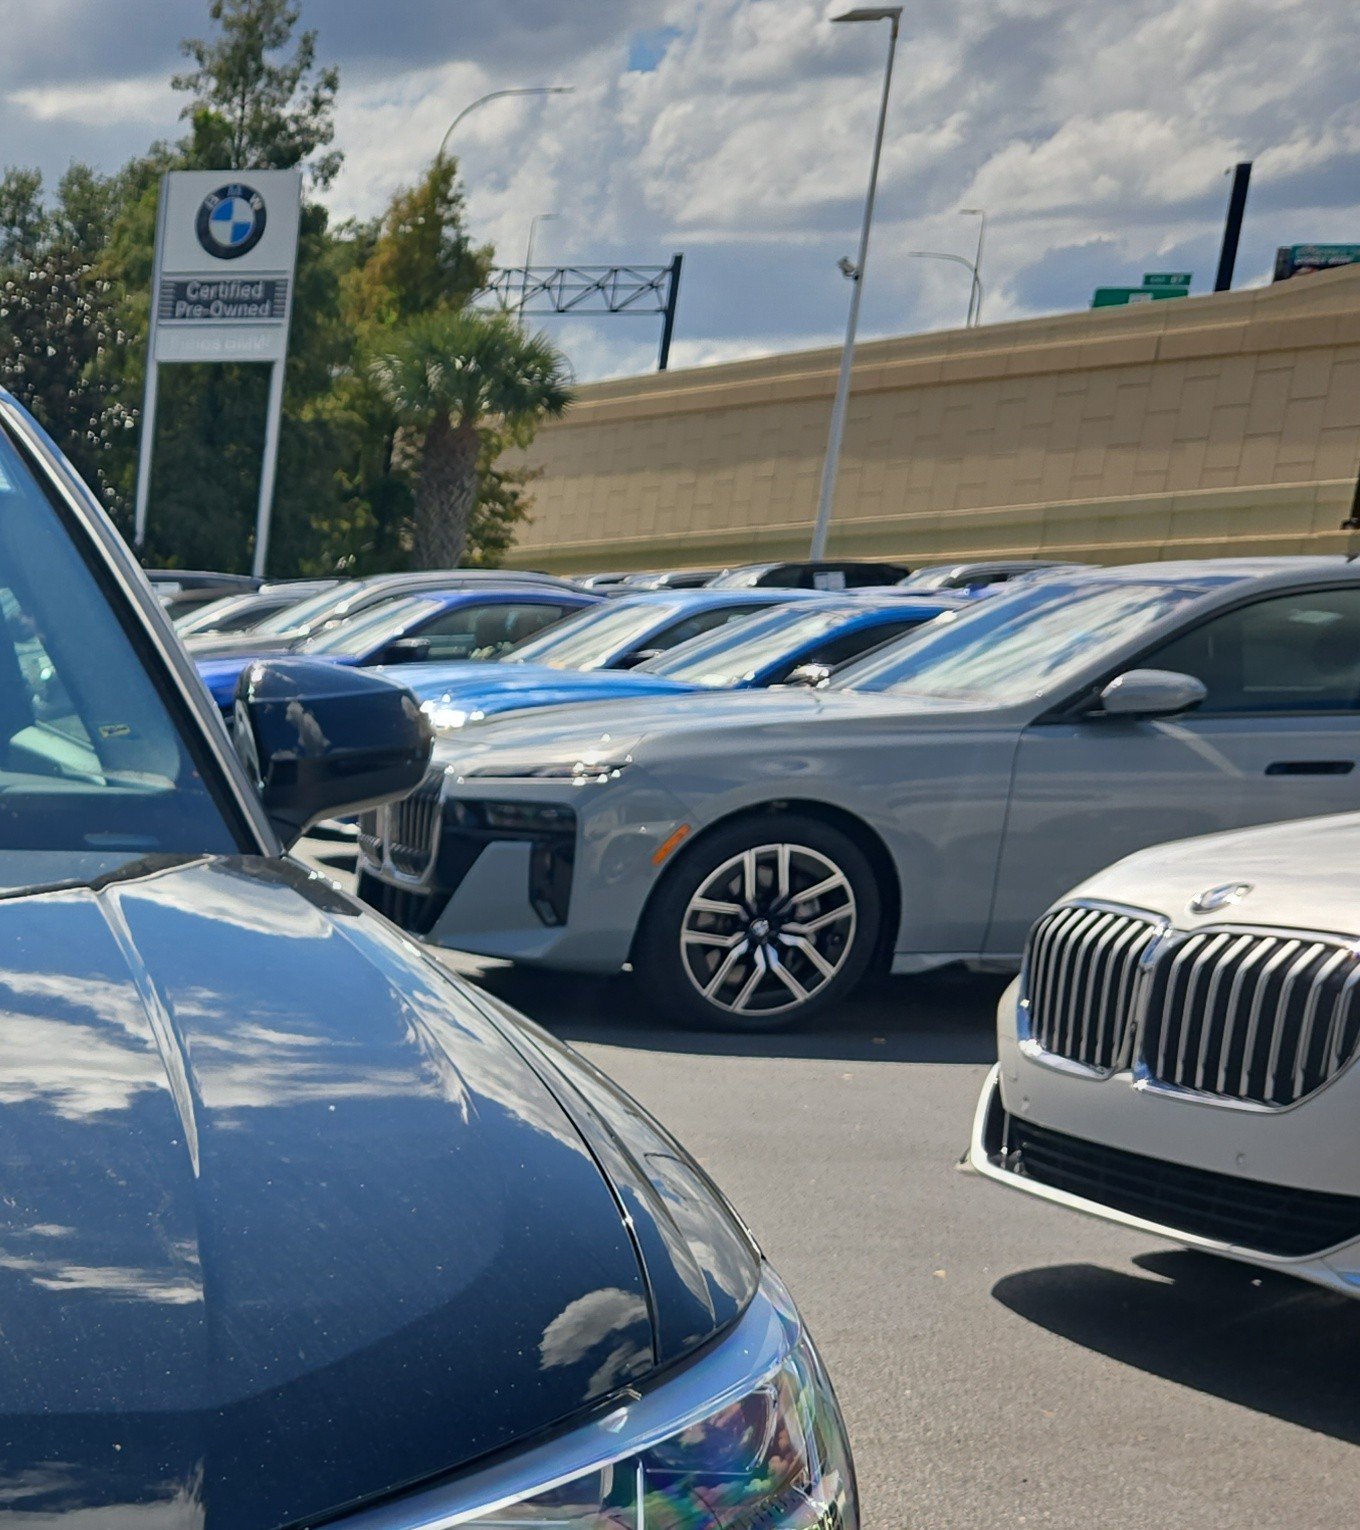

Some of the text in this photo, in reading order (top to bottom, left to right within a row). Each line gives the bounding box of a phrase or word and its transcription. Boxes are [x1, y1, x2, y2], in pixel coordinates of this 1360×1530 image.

[204, 184, 263, 211] BMW
[186, 280, 265, 300] Certified
[175, 300, 271, 318] Pre-Owned
